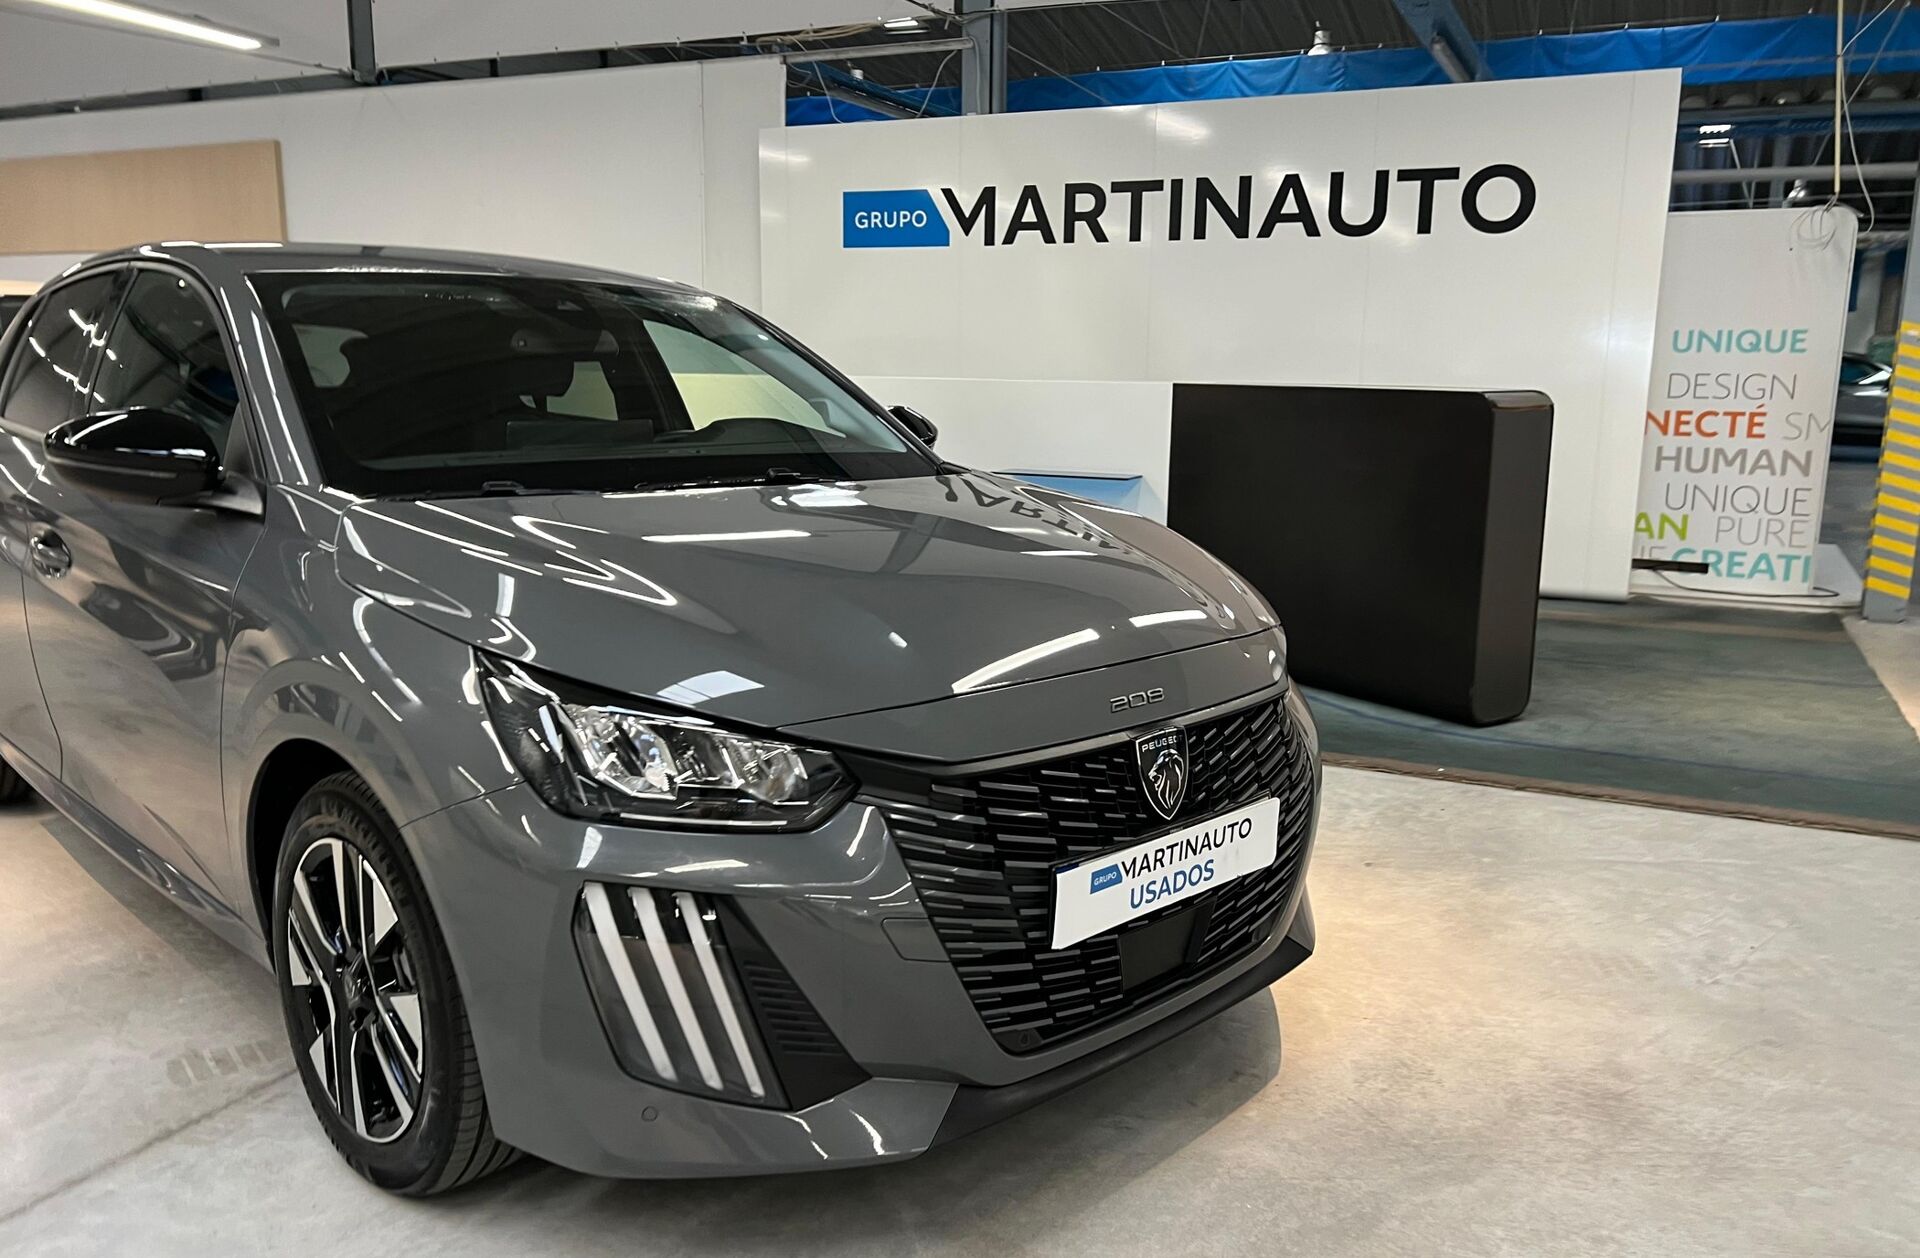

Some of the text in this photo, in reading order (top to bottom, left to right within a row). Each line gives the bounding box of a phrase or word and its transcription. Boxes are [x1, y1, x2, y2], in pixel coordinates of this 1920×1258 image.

[854, 163, 1537, 247] GRUPO MARTINAUTO
[1672, 329, 1809, 354] UNIQUE
[1667, 372, 1797, 400] DESIGN
[1654, 446, 1813, 477] HUMAN
[1665, 482, 1813, 517] UNIQUE
[1715, 516, 1809, 548] PURE
[1110, 687, 1165, 713] 208
[1093, 817, 1252, 886] GRUPO MARTINAUTO
[1130, 858, 1215, 909] USADOS
